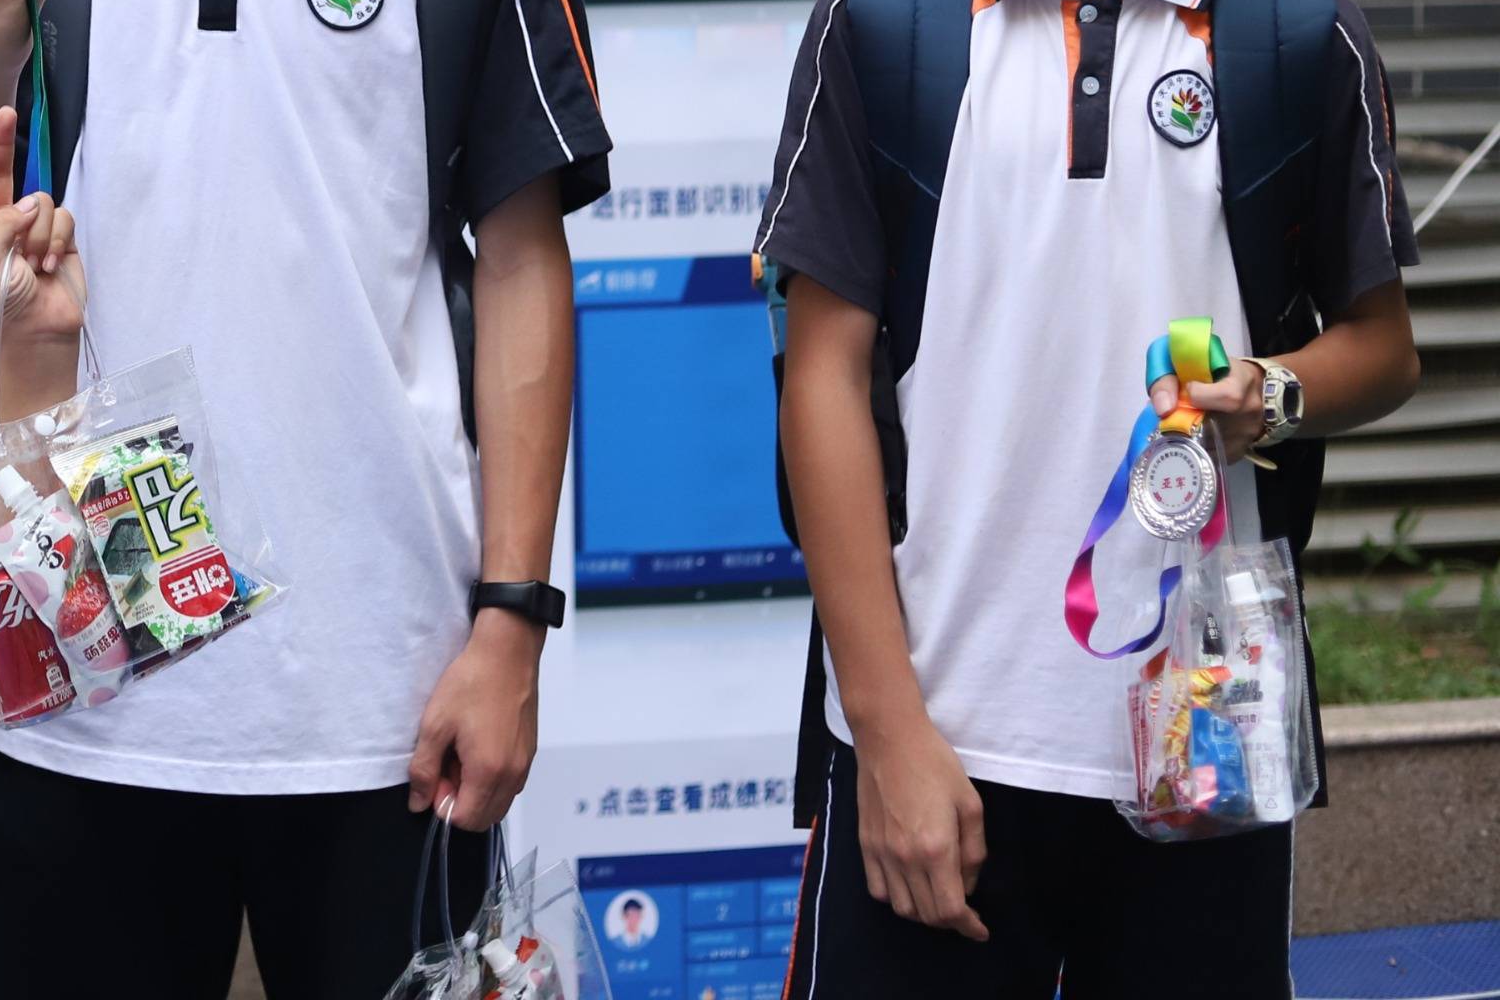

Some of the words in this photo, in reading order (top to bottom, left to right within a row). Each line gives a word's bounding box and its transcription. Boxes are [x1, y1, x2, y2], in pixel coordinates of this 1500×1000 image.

[1161, 476, 1186, 490] 亚军
[132, 464, 198, 554] 김
[167, 563, 230, 608] 해표
[598, 778, 793, 817] 点击查看成绩和
